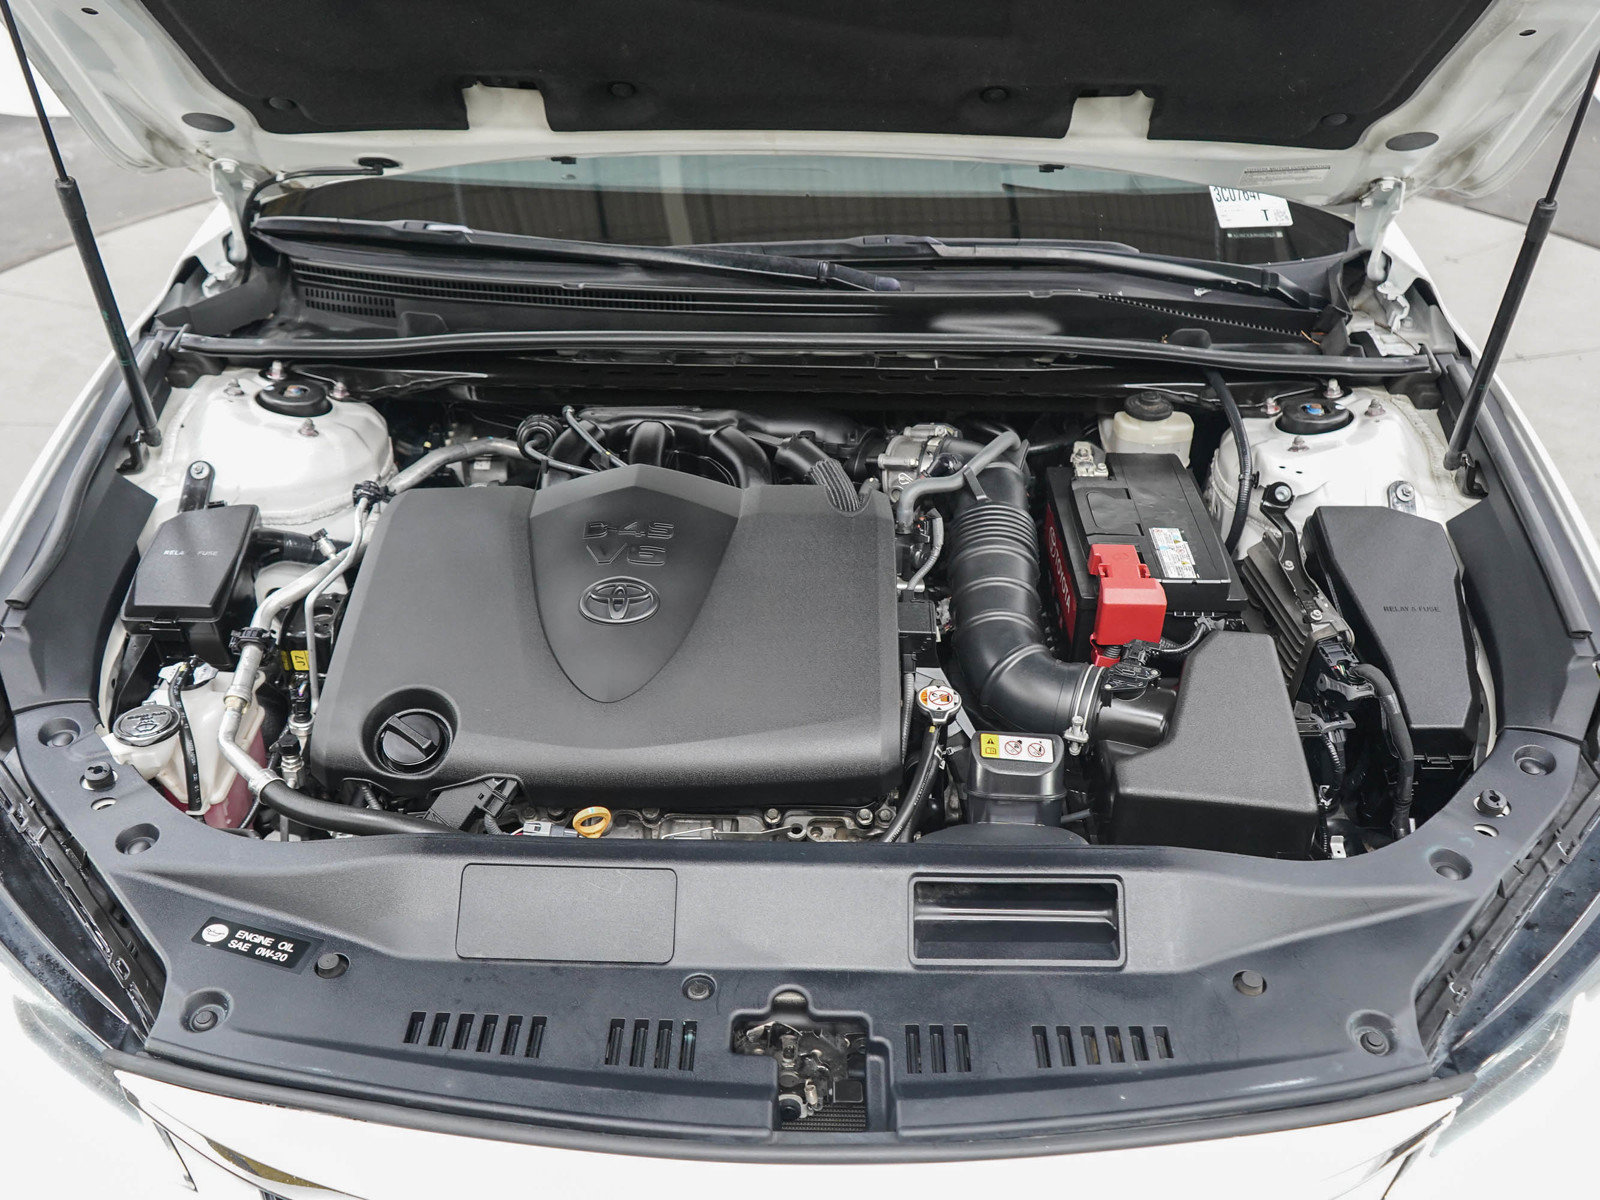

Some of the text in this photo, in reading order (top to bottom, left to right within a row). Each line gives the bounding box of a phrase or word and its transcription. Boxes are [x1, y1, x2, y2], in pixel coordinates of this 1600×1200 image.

[1261, 209, 1269, 221] T
[586, 542, 667, 567] V6
[228, 940, 288, 962] SAE 0W-20
[235, 930, 294, 953] ENGINE OIL
